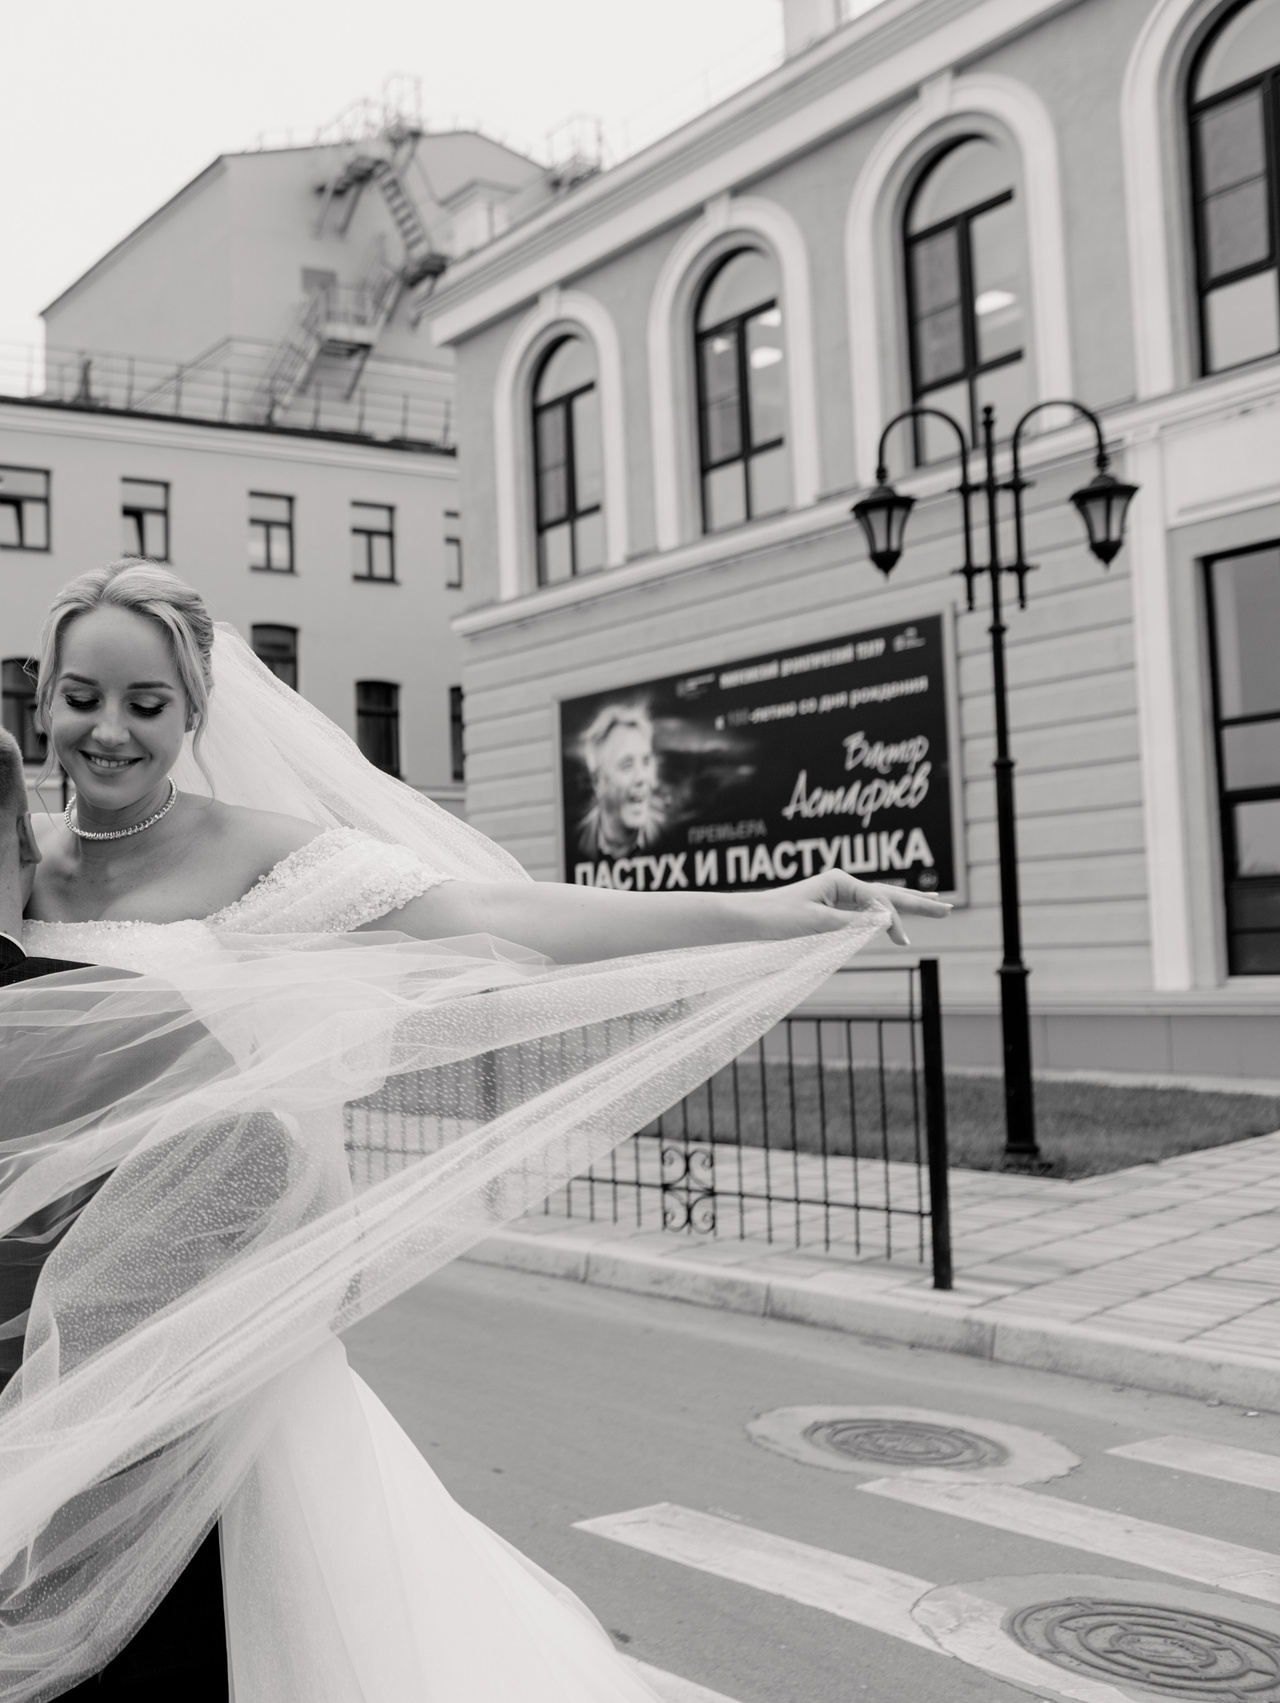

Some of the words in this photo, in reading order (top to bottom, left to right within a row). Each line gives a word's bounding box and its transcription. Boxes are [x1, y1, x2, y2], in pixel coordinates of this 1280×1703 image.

[798, 697, 817, 715] со
[818, 691, 848, 713] дня
[849, 675, 928, 709] рождения
[842, 730, 929, 774] Виктор
[782, 760, 931, 828] Астафьев
[687, 819, 767, 845] ПРЕМЬЕРА
[575, 852, 689, 891] ПАСТУХ
[694, 849, 718, 887] И
[726, 827, 934, 884] ПАСТУШКА
